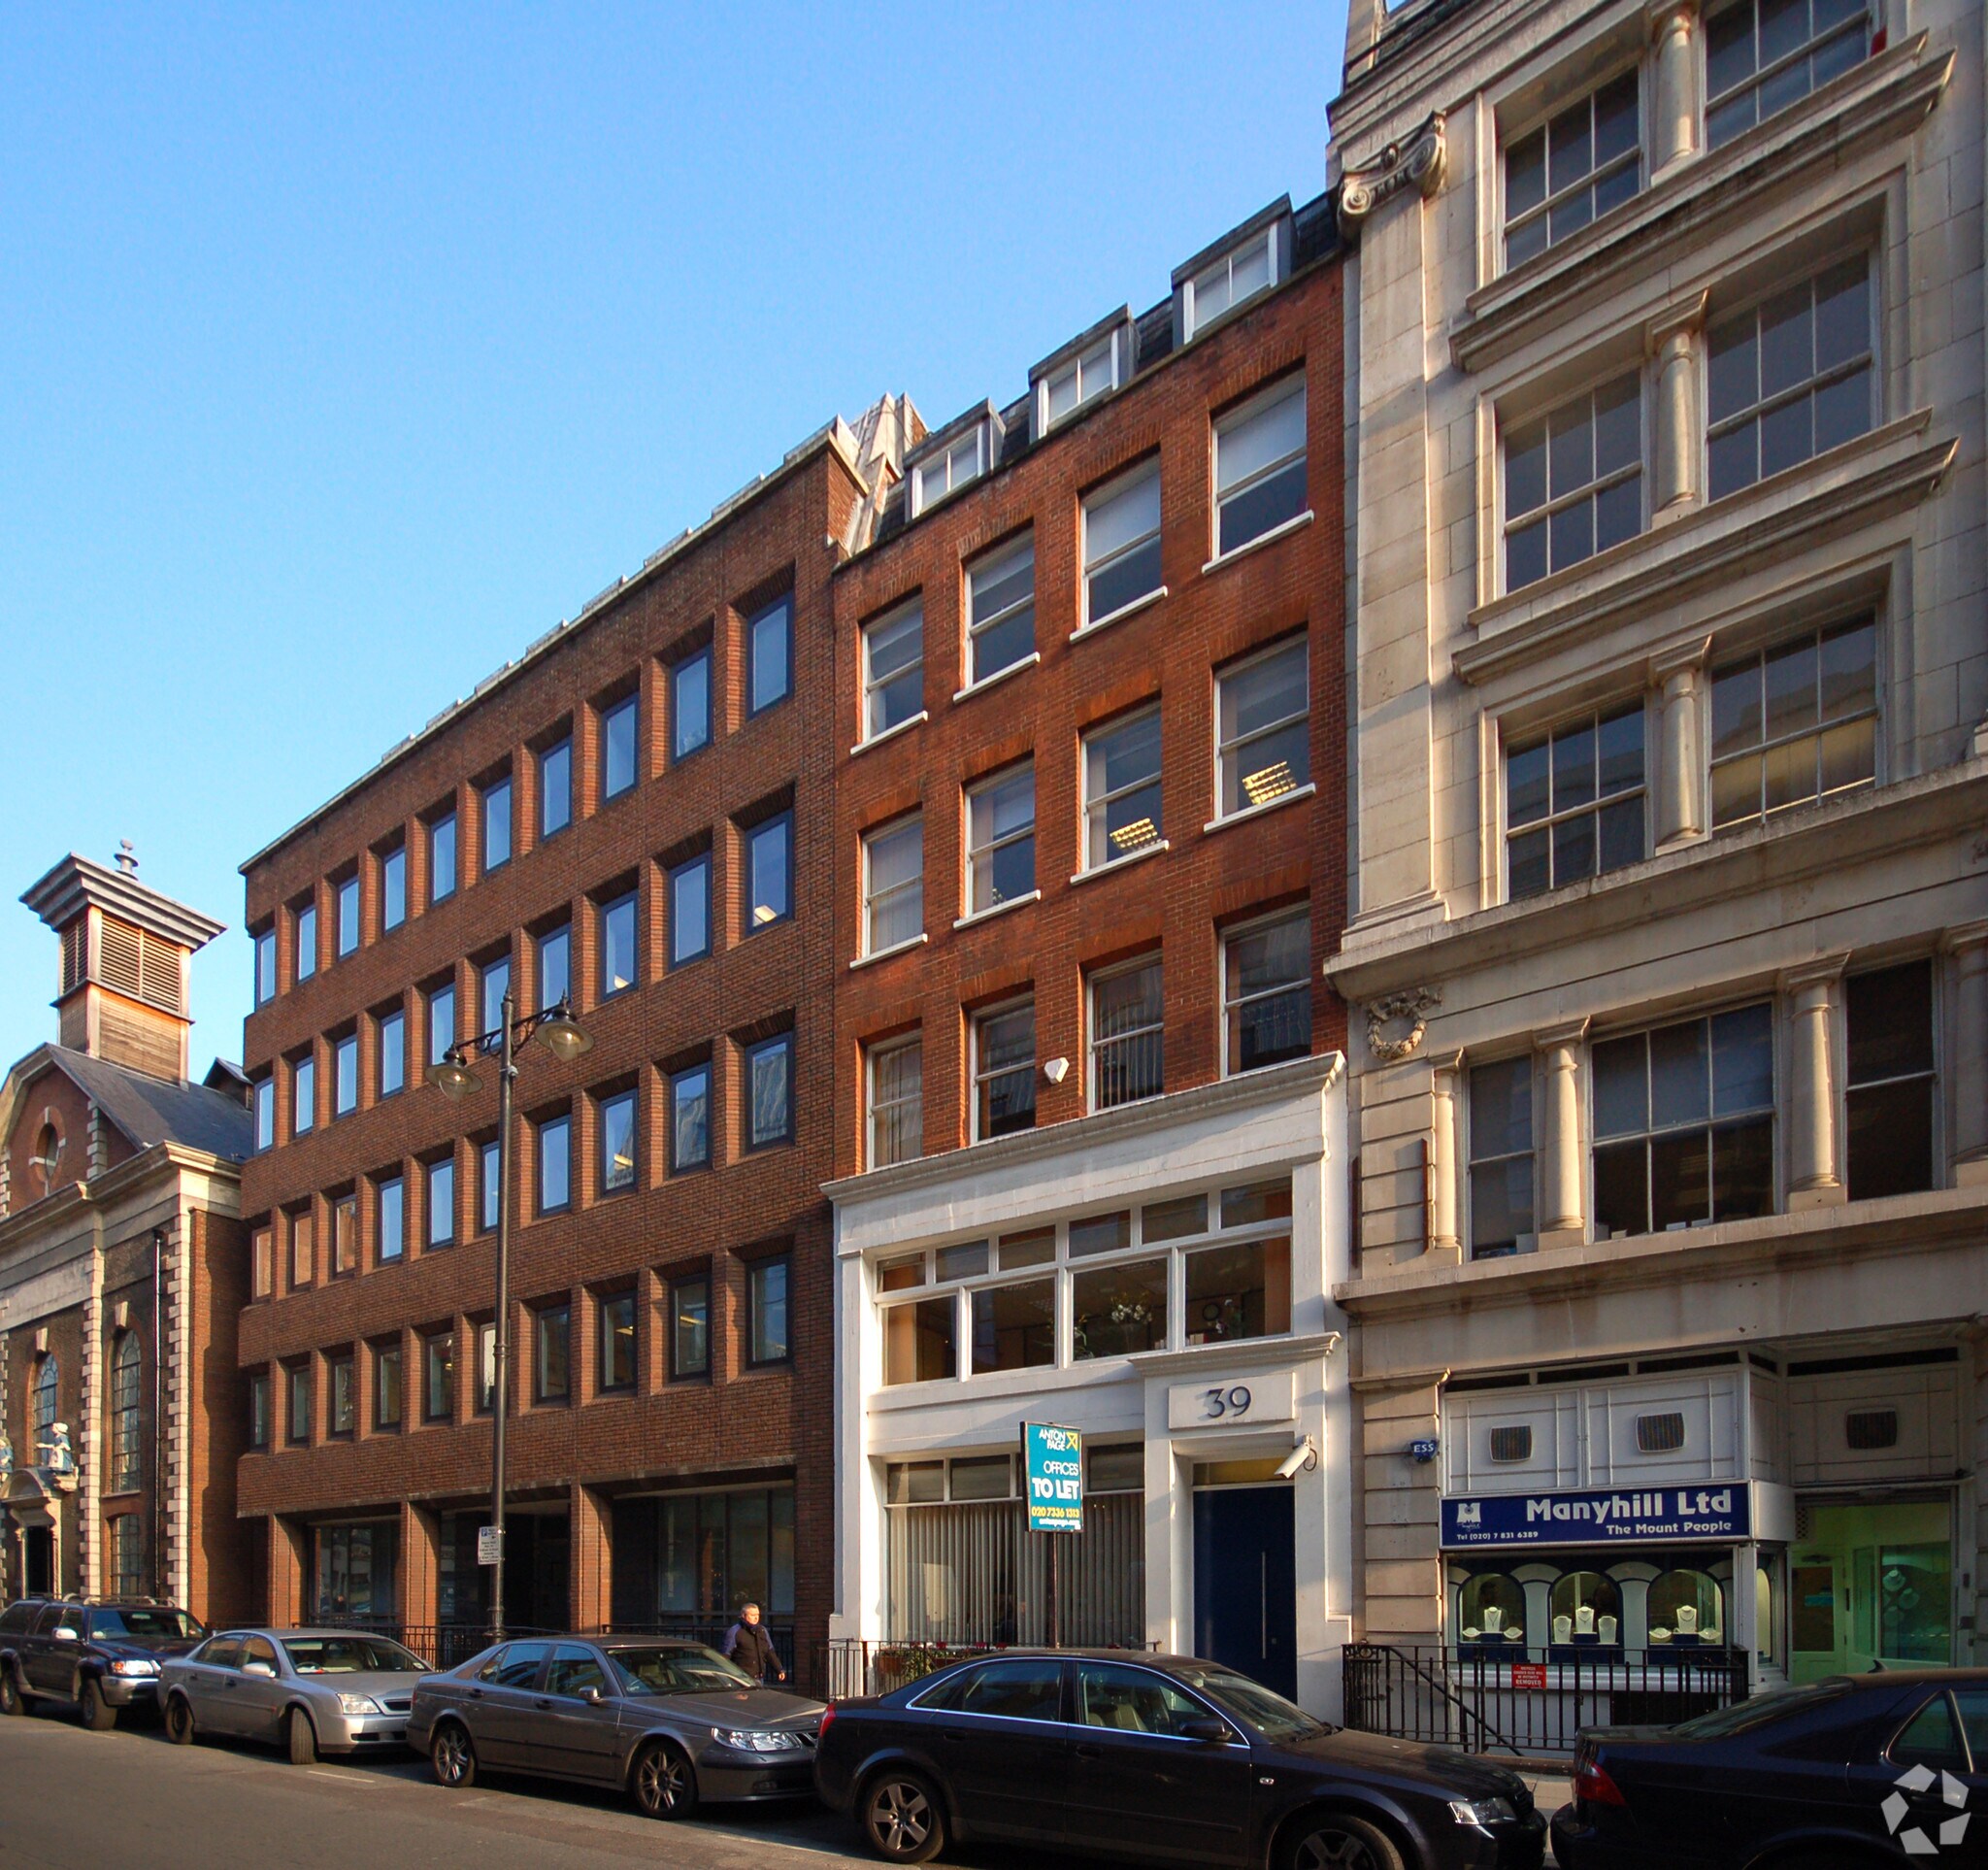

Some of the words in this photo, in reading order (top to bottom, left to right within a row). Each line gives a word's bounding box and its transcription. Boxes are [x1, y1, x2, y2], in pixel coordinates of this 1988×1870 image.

[1208, 1386, 1252, 1419] 39
[1039, 1428, 1066, 1441] ANTON
[1047, 1439, 1066, 1452] PAGE
[1413, 1443, 1434, 1453] ESS
[1044, 1460, 1078, 1476] OFFICES
[1032, 1477, 1054, 1499] TO
[1055, 1478, 1079, 1500] LET
[1031, 1506, 1047, 1518] 020
[1526, 1492, 1663, 1524] Manyhill
[1677, 1489, 1732, 1516] Ltd
[1607, 1524, 1631, 1535] The
[1636, 1522, 1678, 1534] Mount
[1683, 1520, 1732, 1533] People
[1470, 1532, 1491, 1541] (020)
